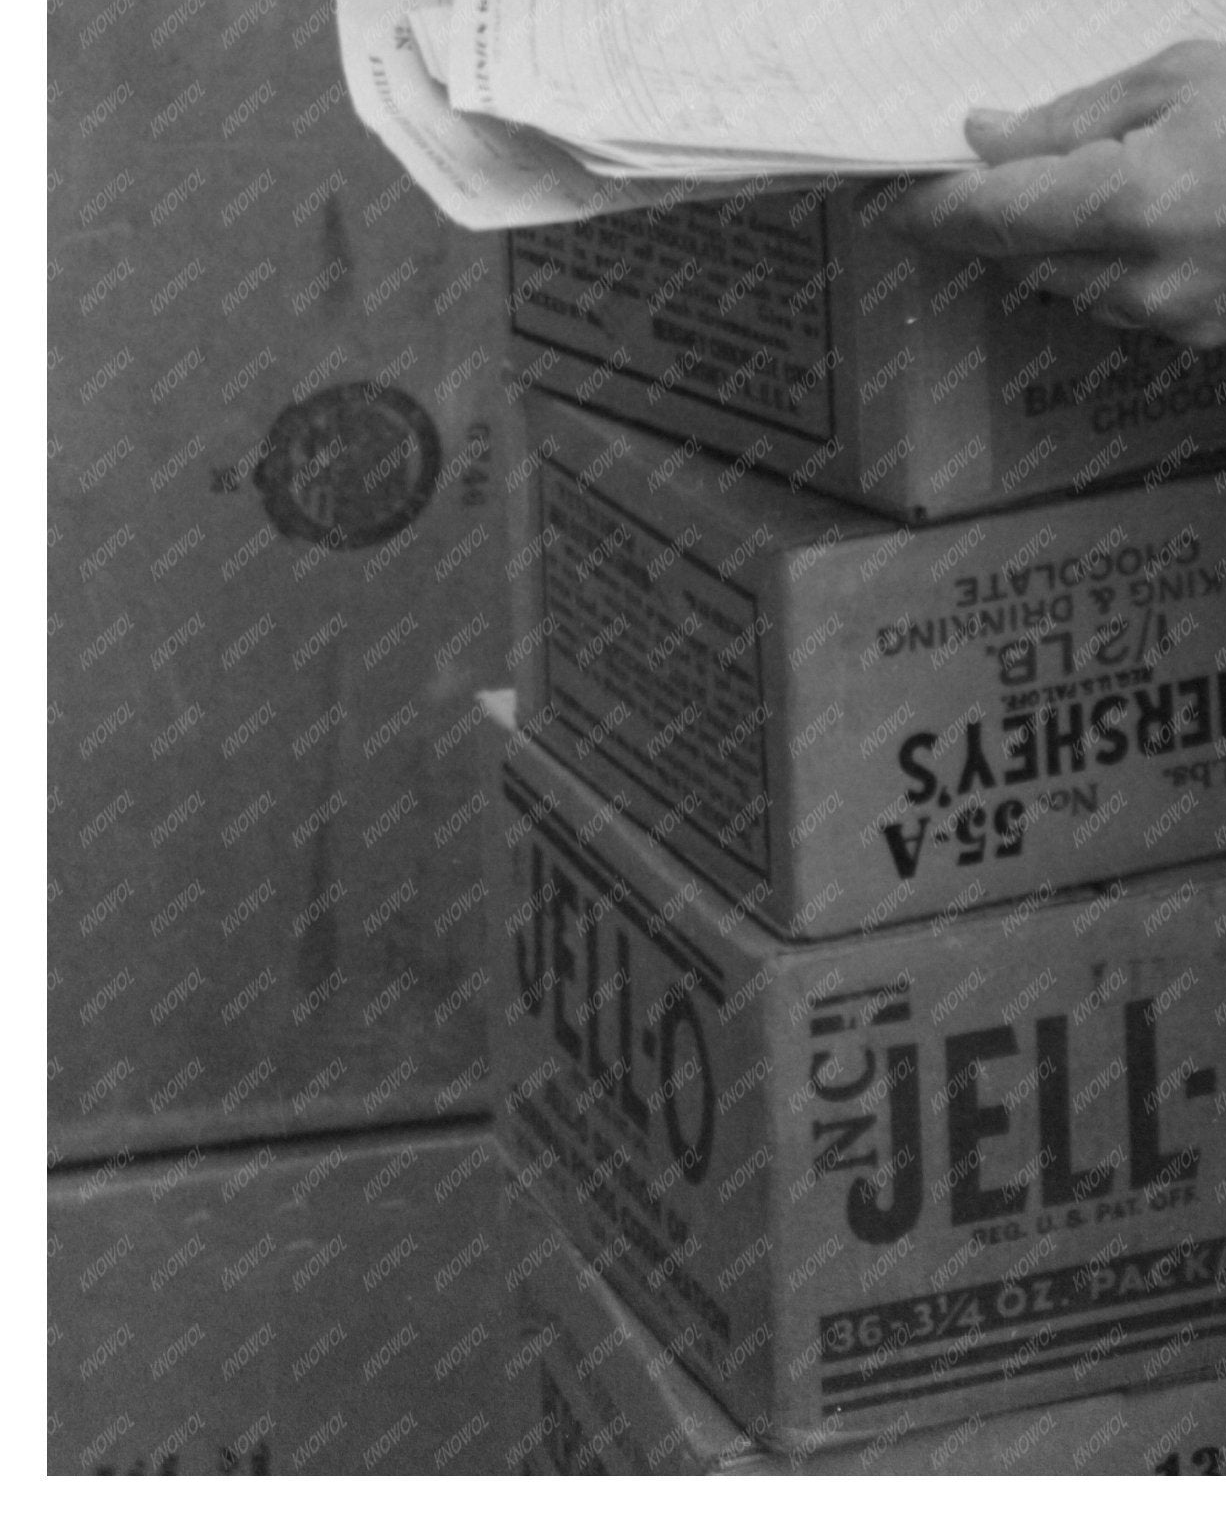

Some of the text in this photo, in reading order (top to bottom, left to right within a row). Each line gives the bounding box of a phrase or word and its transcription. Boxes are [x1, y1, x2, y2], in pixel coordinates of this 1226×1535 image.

[953, 536, 1200, 609] CHOCOLATE
[1087, 587, 1117, 616] &
[875, 594, 1075, 658] DRINKING
[984, 609, 1175, 687] 1/2 LB.
[1037, 782, 1100, 819] No.
[879, 799, 1026, 882] 55-A
[516, 843, 716, 1185] JELL-O
[971, 1217, 1028, 1247] REG.
[995, 1278, 1070, 1321] OZ.
